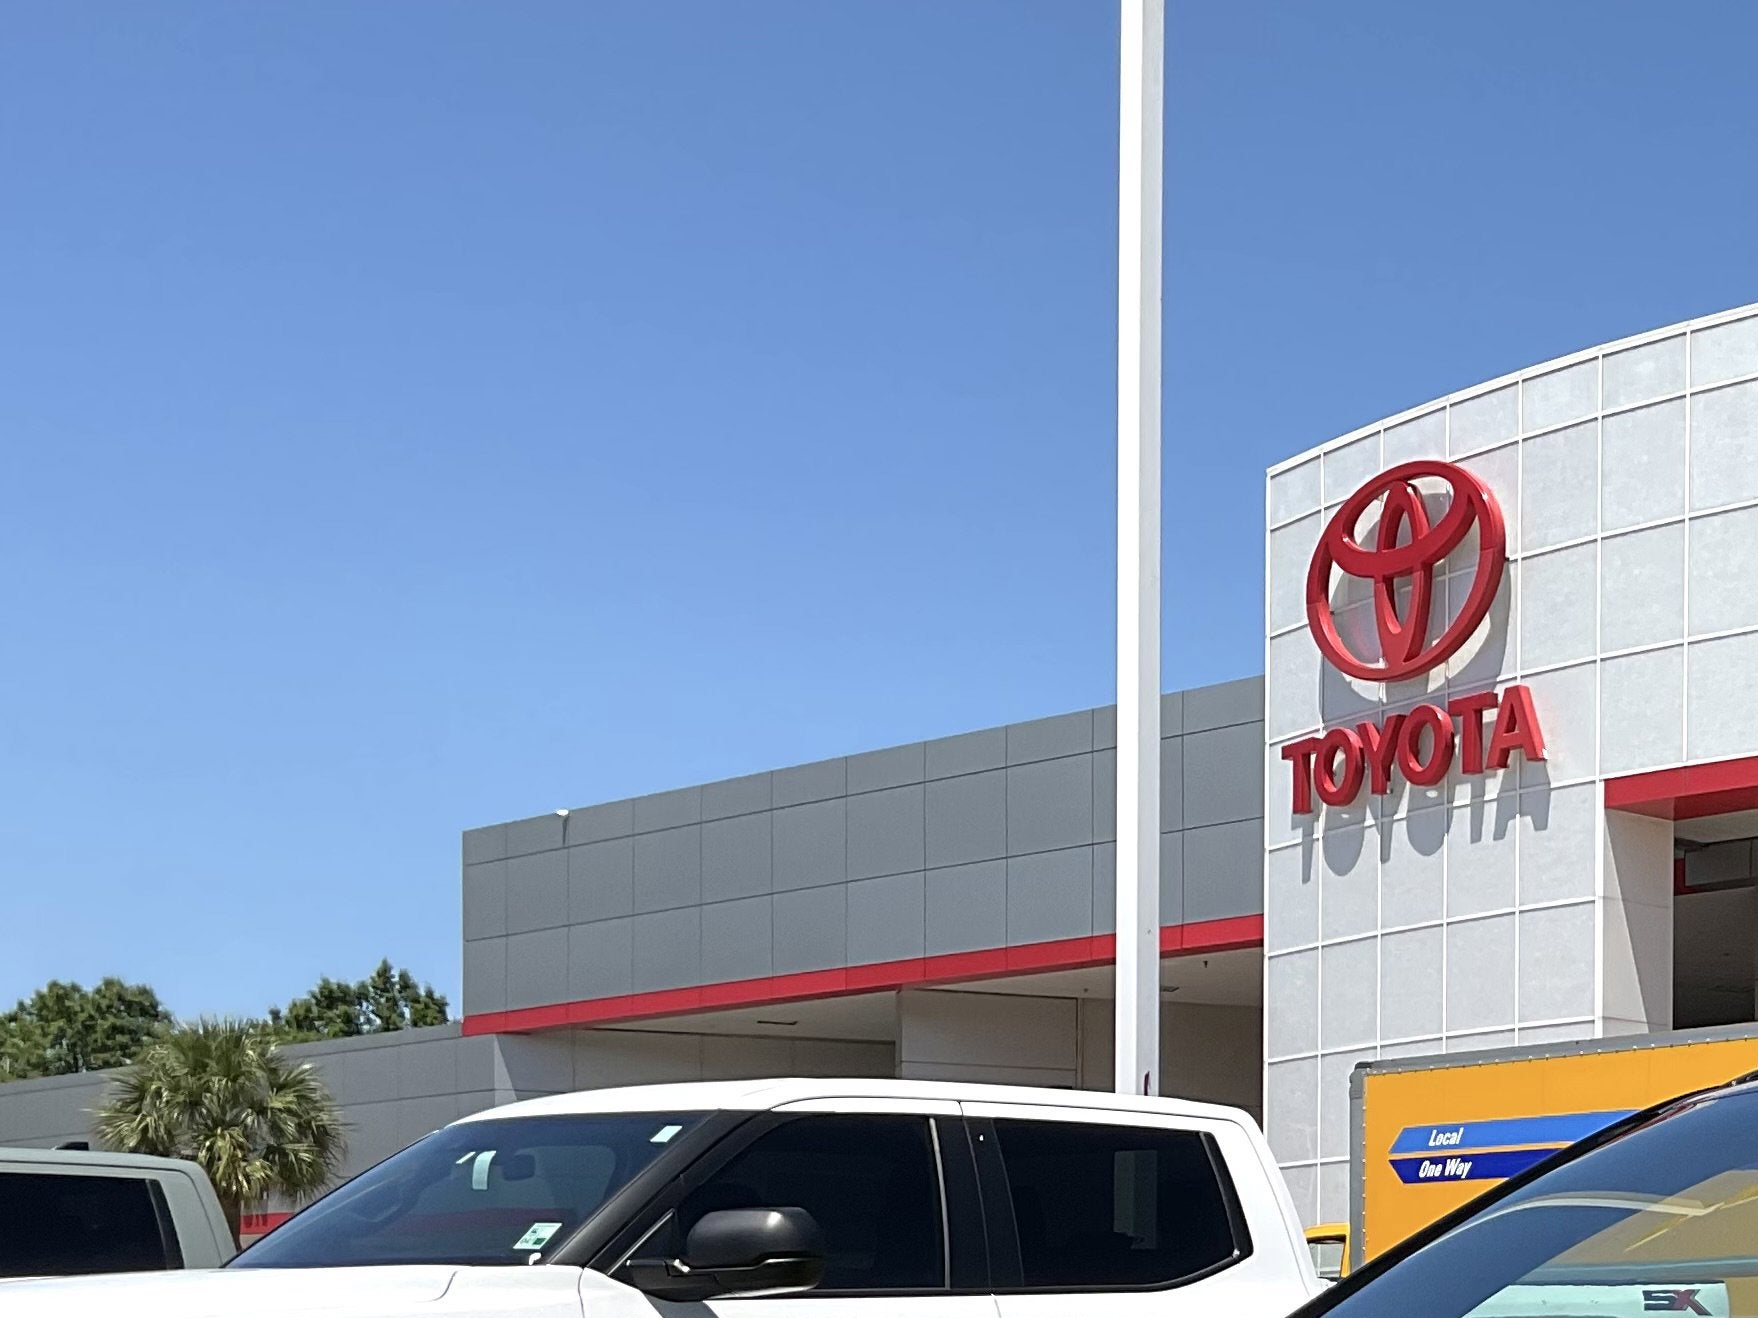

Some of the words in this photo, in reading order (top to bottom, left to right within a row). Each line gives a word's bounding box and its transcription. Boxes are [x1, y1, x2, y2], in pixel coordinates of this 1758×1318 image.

[1281, 684, 1547, 814] TOYOTA
[1428, 1127, 1464, 1147] Local
[1418, 1160, 1442, 1178] One
[1444, 1158, 1472, 1179] Way
